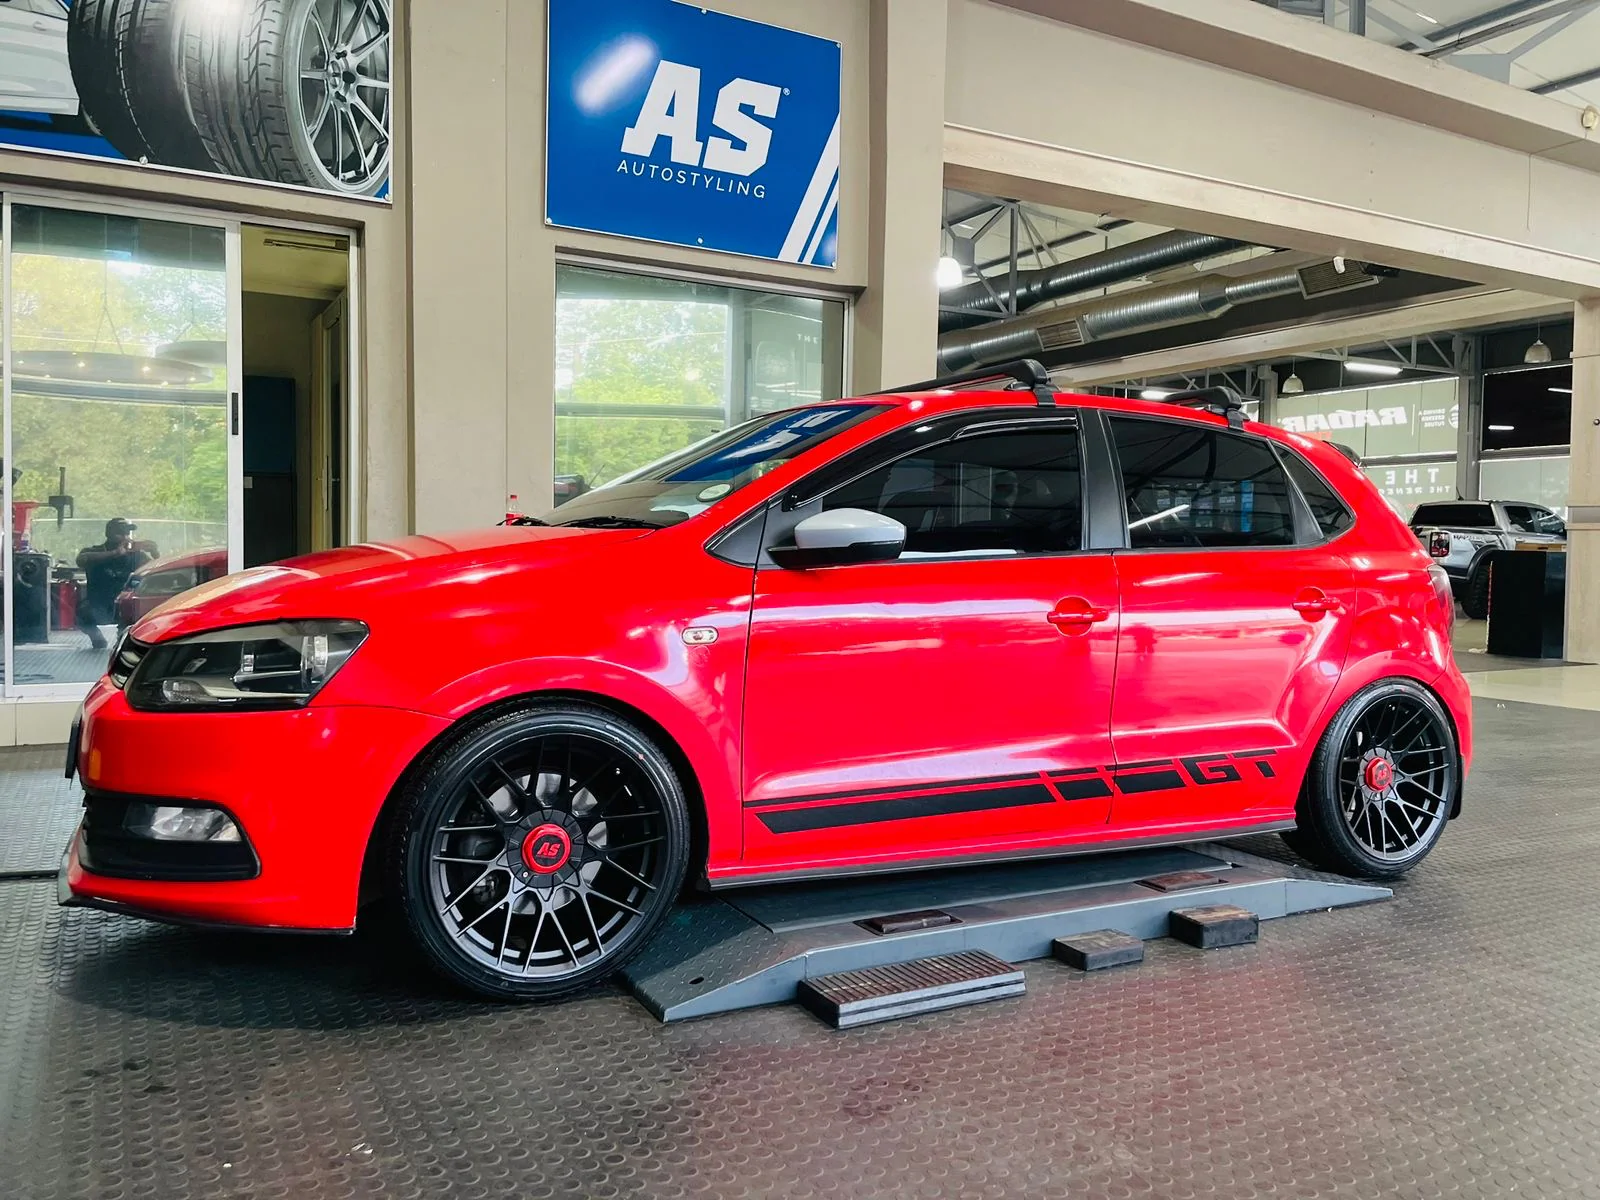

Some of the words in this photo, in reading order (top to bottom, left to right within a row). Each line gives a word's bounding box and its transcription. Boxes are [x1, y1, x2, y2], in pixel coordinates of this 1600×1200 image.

[617, 160, 766, 199] AUTOSTYLING
[1179, 748, 1278, 785] GT
[537, 842, 560, 856] AS
